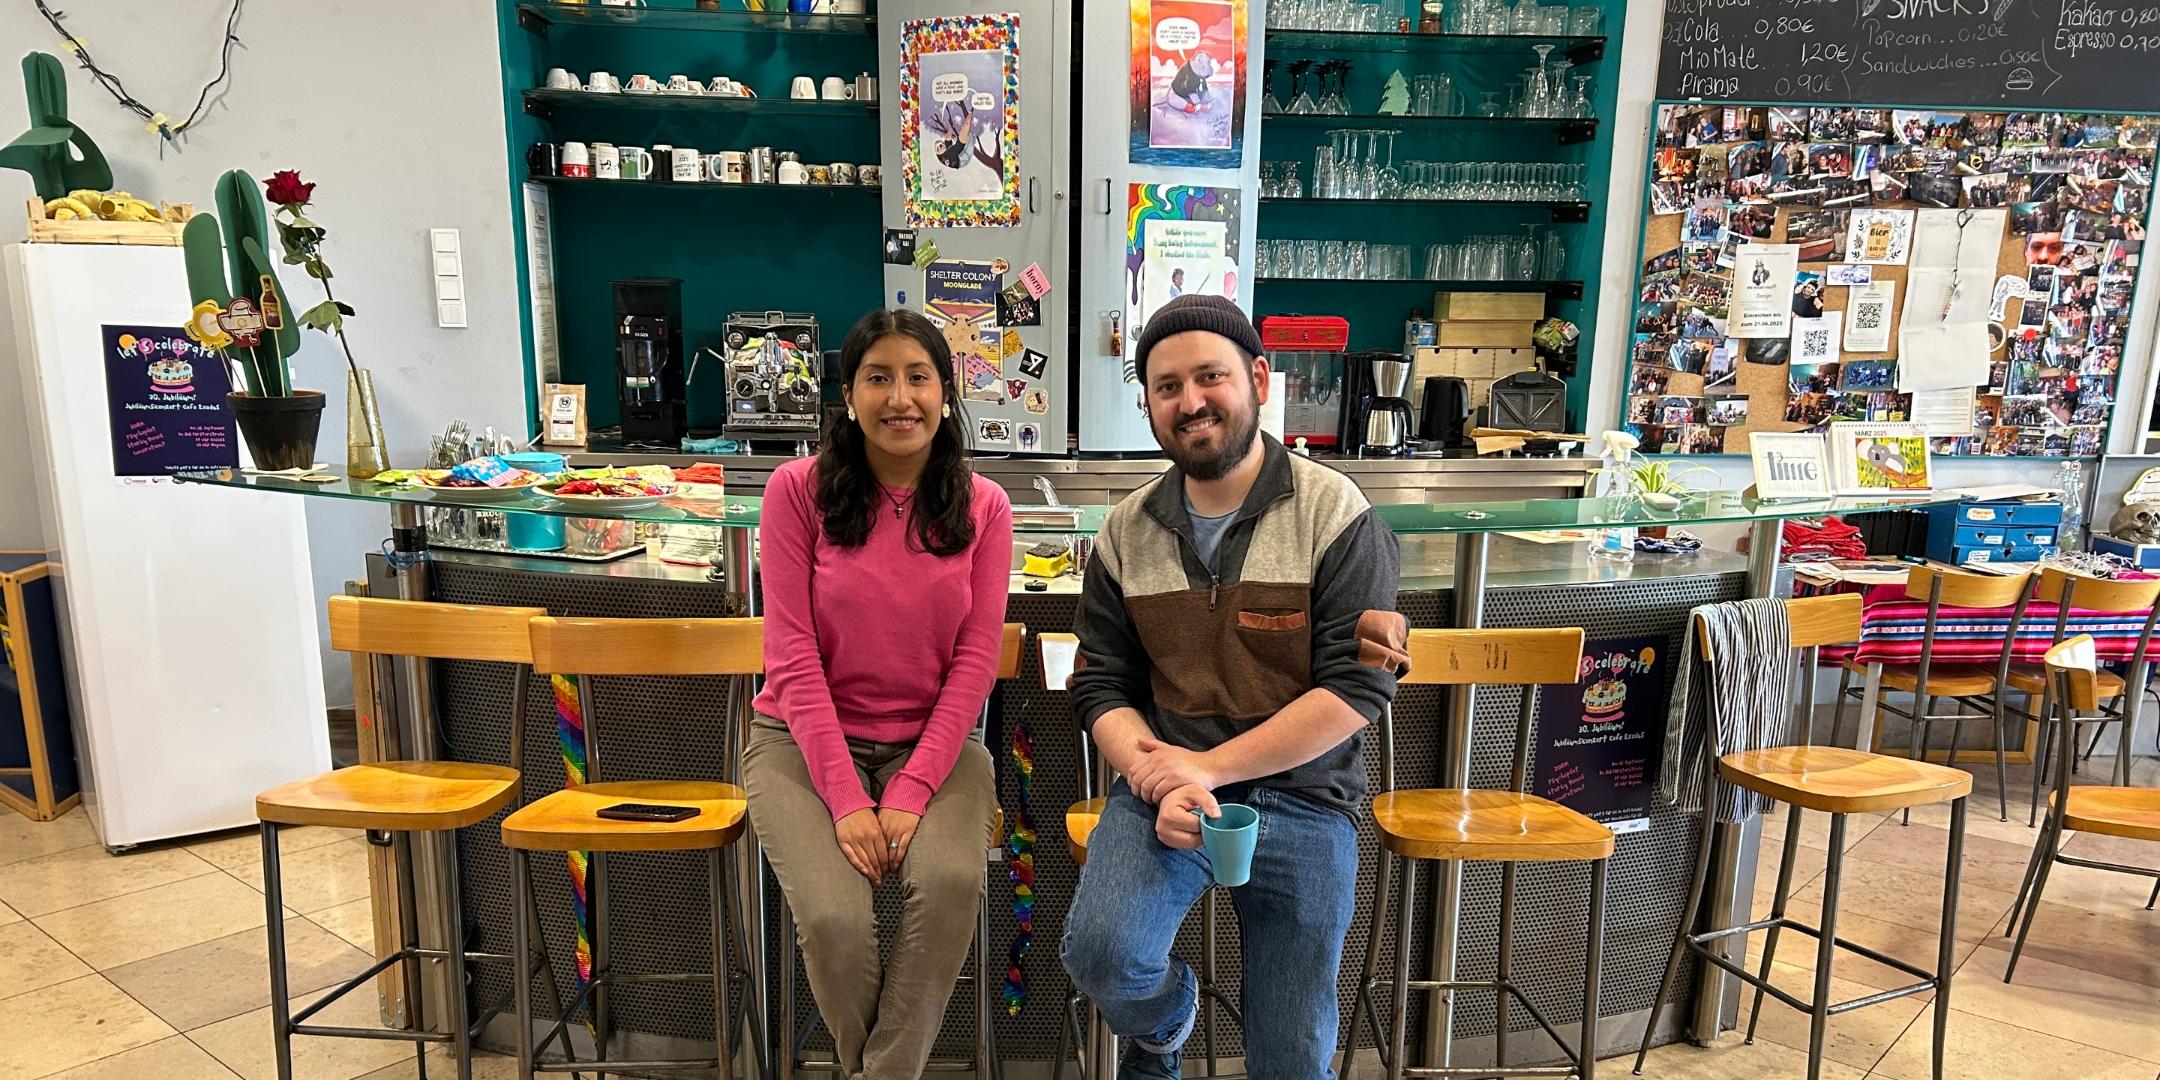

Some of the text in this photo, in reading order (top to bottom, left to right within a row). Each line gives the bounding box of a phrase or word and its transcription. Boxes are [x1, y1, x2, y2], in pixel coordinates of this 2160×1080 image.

[2058, 0, 2160, 28] Kakao 0,80
[1684, 17, 1720, 43] Cola
[1755, 17, 1815, 40] 0,80€
[1863, 18, 1932, 48] Popcorn
[1801, 42, 1850, 67] 1,20€
[2054, 28, 2116, 58] Espresso
[1861, 51, 1976, 75] Sandwiches
[1681, 72, 1740, 97] Piranja
[1870, 228, 1889, 236] Bier
[930, 270, 997, 281] SHELTER COLONY
[1026, 268, 1043, 294] horny
[1594, 651, 1651, 674] celebrate
[1578, 725, 1590, 733] 30.
